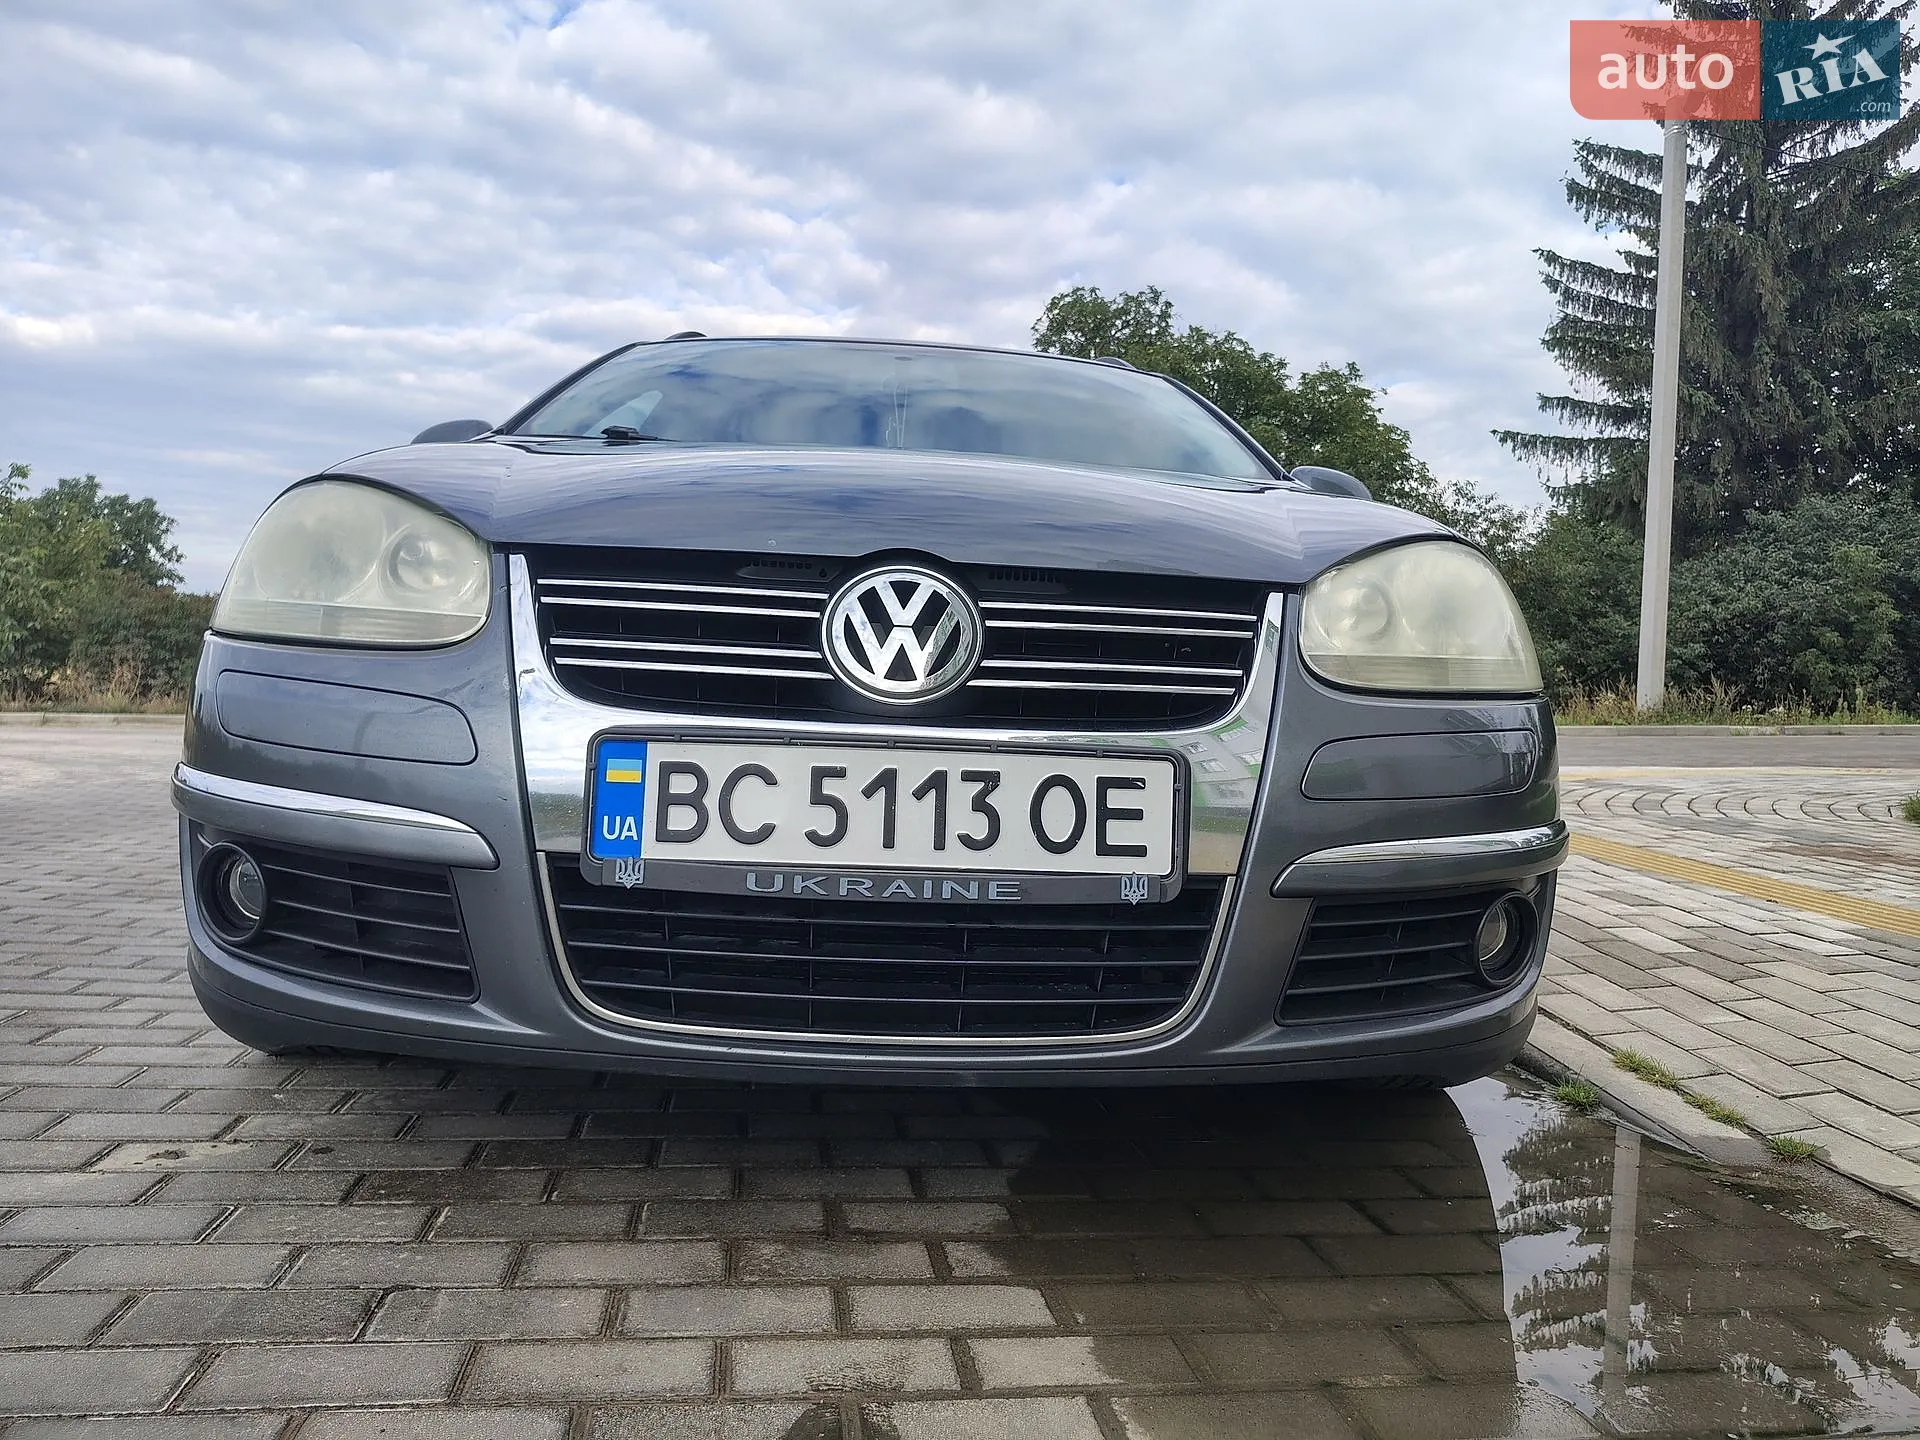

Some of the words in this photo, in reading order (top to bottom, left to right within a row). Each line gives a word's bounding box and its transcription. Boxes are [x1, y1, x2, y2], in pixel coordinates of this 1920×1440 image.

[832, 572, 974, 694] VW
[602, 815, 639, 841] UA
[655, 760, 779, 845] BC
[803, 765, 1001, 851] 5113
[1029, 773, 1148, 858] OE
[745, 871, 1022, 901] UKRAINE
